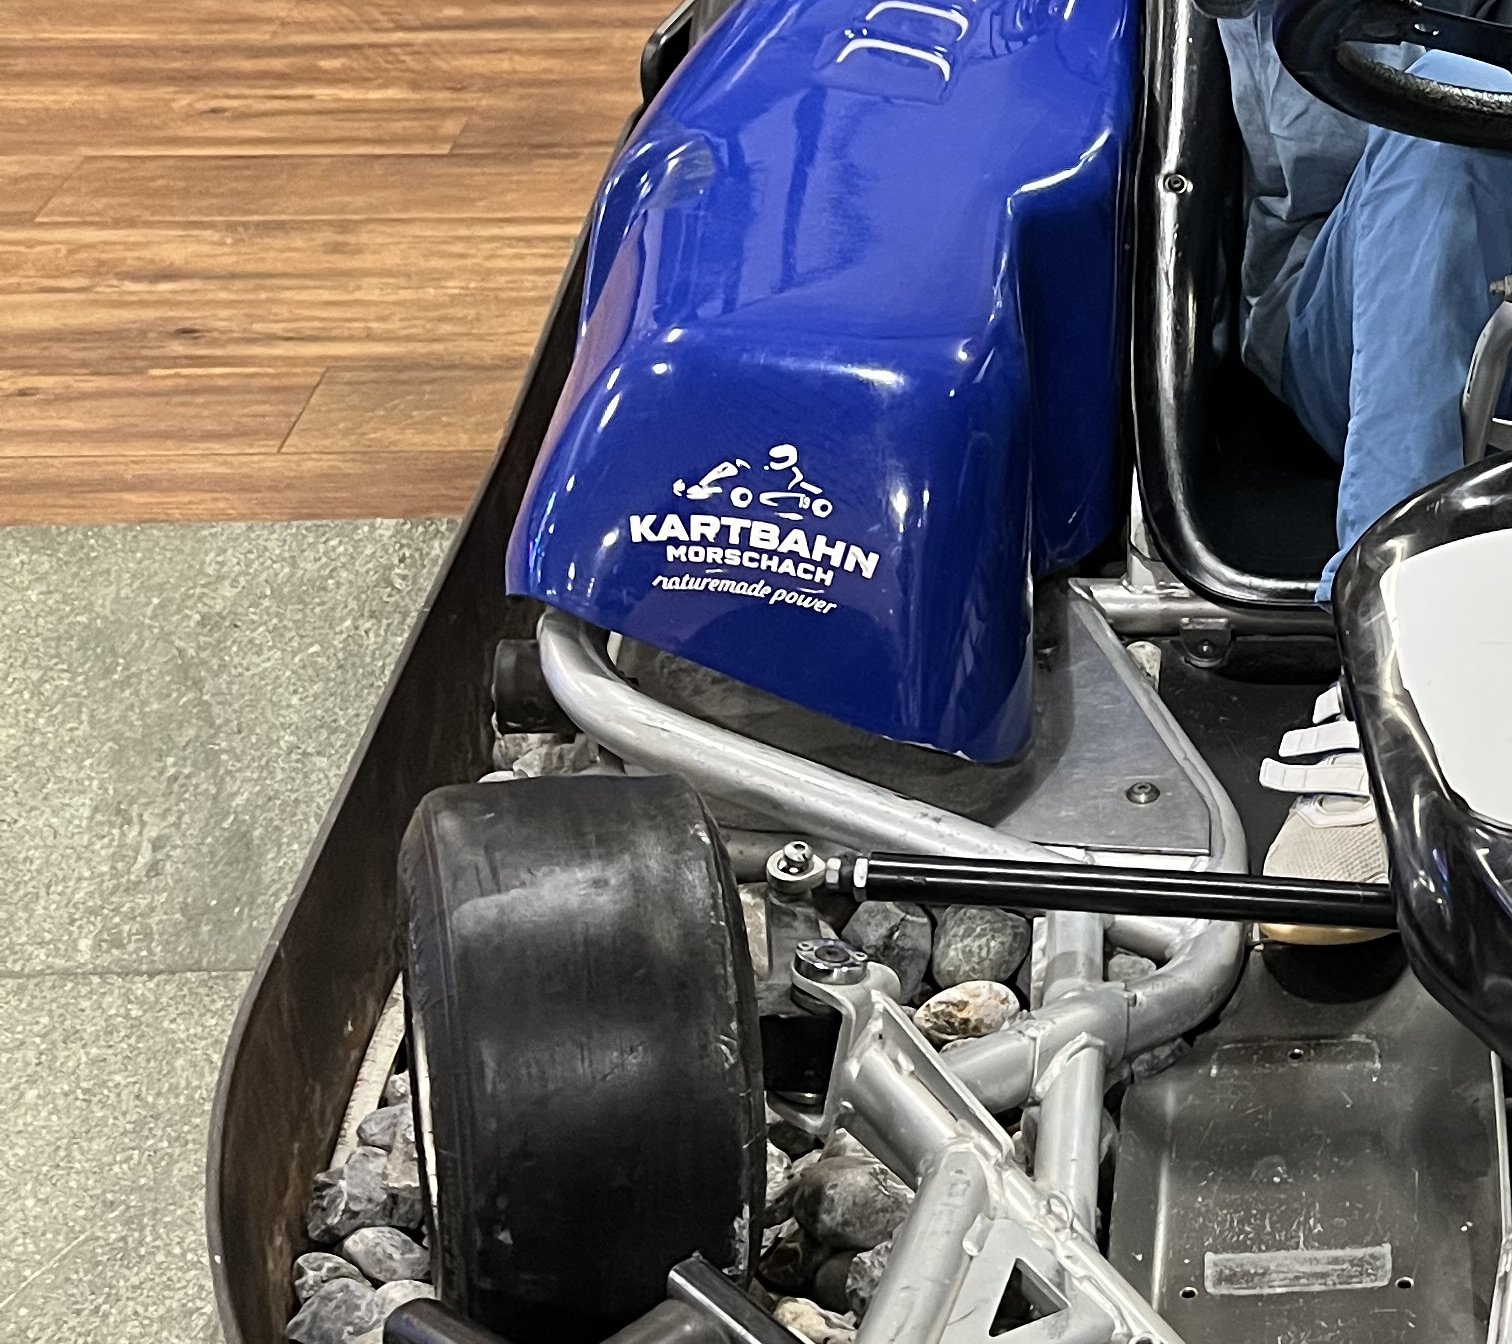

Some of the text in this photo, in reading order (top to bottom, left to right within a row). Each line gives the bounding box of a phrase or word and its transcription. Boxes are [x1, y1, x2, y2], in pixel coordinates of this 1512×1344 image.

[629, 513, 880, 579] KARTBAHN
[666, 544, 835, 586] MORSCHACH
[651, 573, 838, 615] naturemade power
